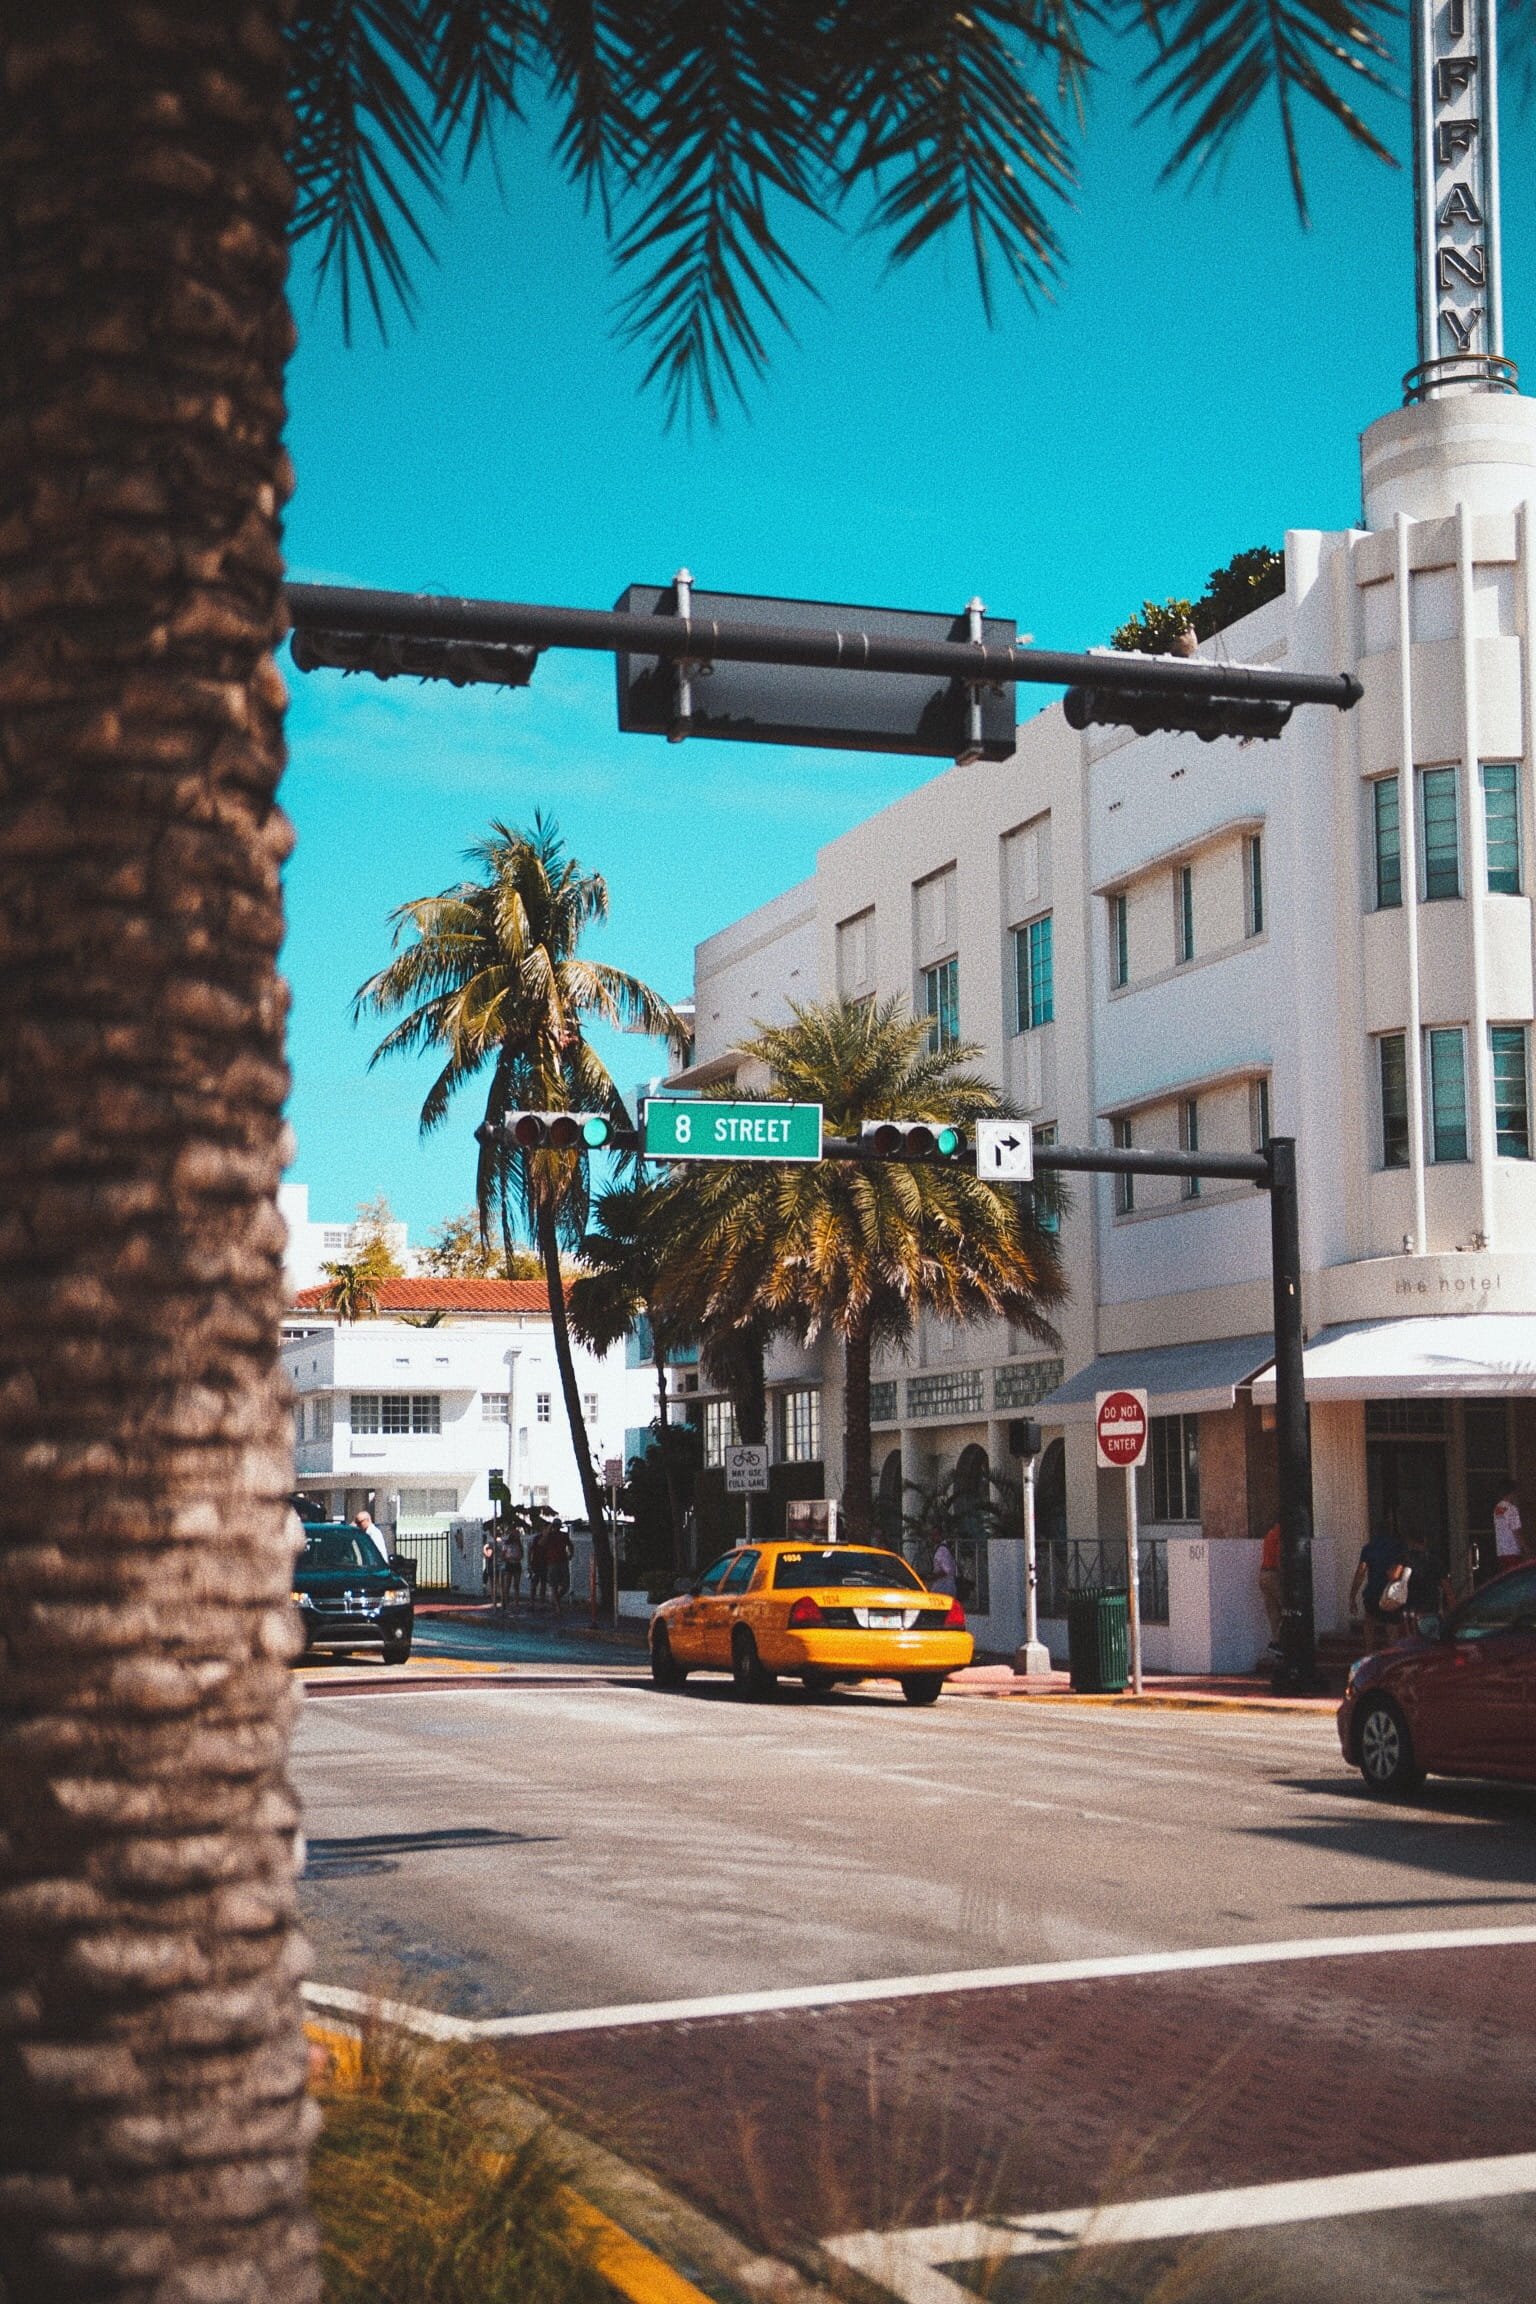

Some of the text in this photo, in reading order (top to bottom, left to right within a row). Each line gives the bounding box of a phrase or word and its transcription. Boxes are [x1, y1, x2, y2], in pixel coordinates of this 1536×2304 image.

[675, 1114, 792, 1143] 8 STREET
[1395, 1274, 1501, 1295] the hotel
[1104, 1405, 1138, 1418] DO NOT
[1108, 1438, 1137, 1451] ENTER
[731, 1469, 762, 1478] MAY USE
[728, 1479, 765, 1488] FULL LANE
